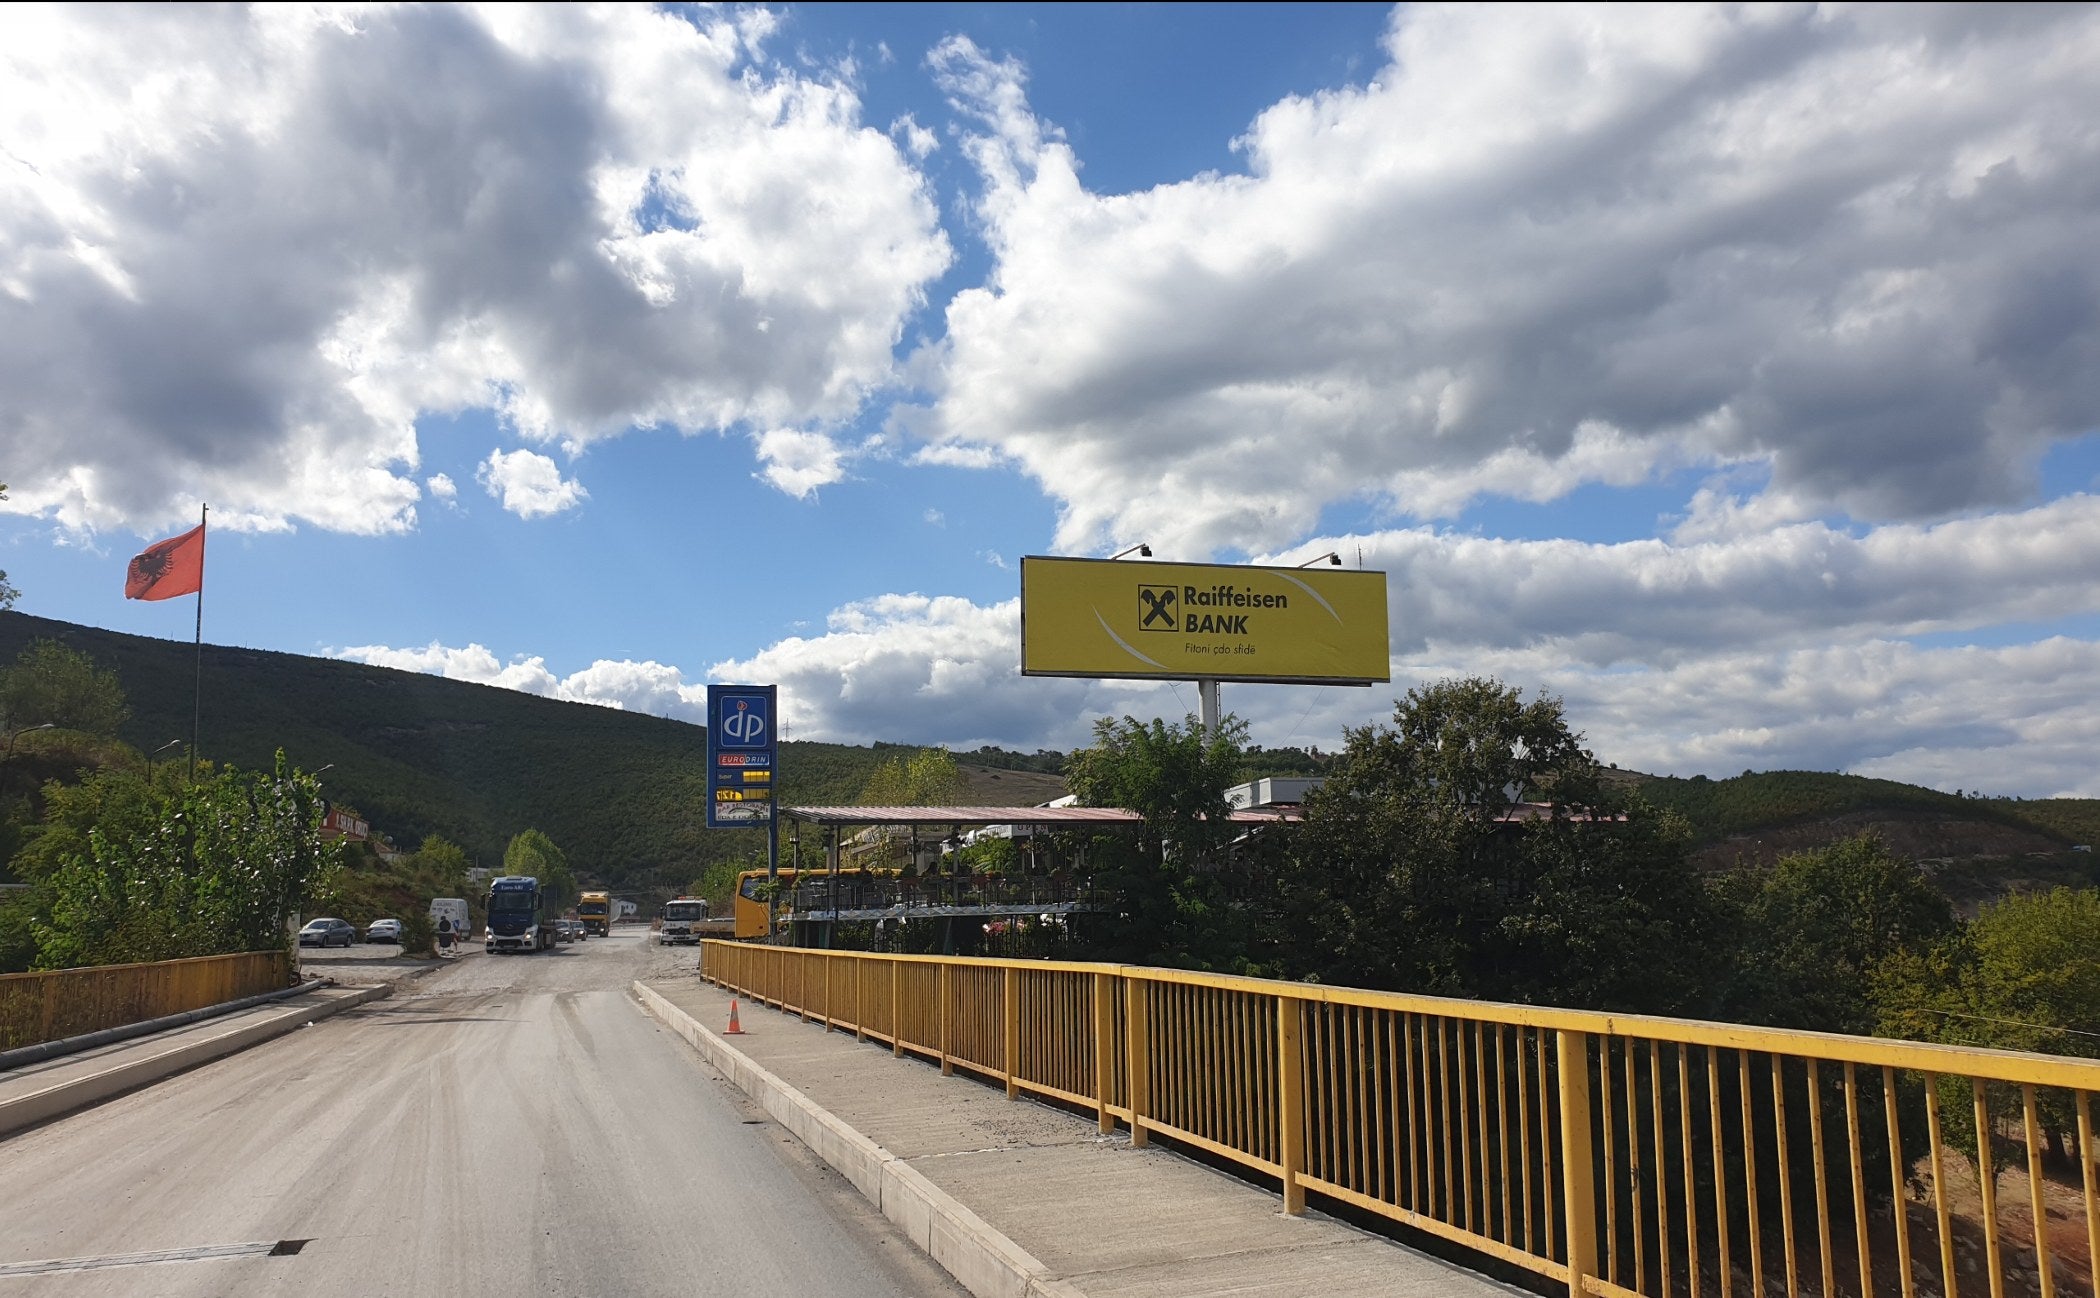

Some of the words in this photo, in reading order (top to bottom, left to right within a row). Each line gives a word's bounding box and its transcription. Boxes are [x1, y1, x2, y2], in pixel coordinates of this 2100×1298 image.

[1184, 586, 1288, 609] Raiffeisen
[1185, 613, 1249, 635] BANK
[1185, 642, 1211, 654] Fitoni
[1213, 643, 1231, 655] çdo
